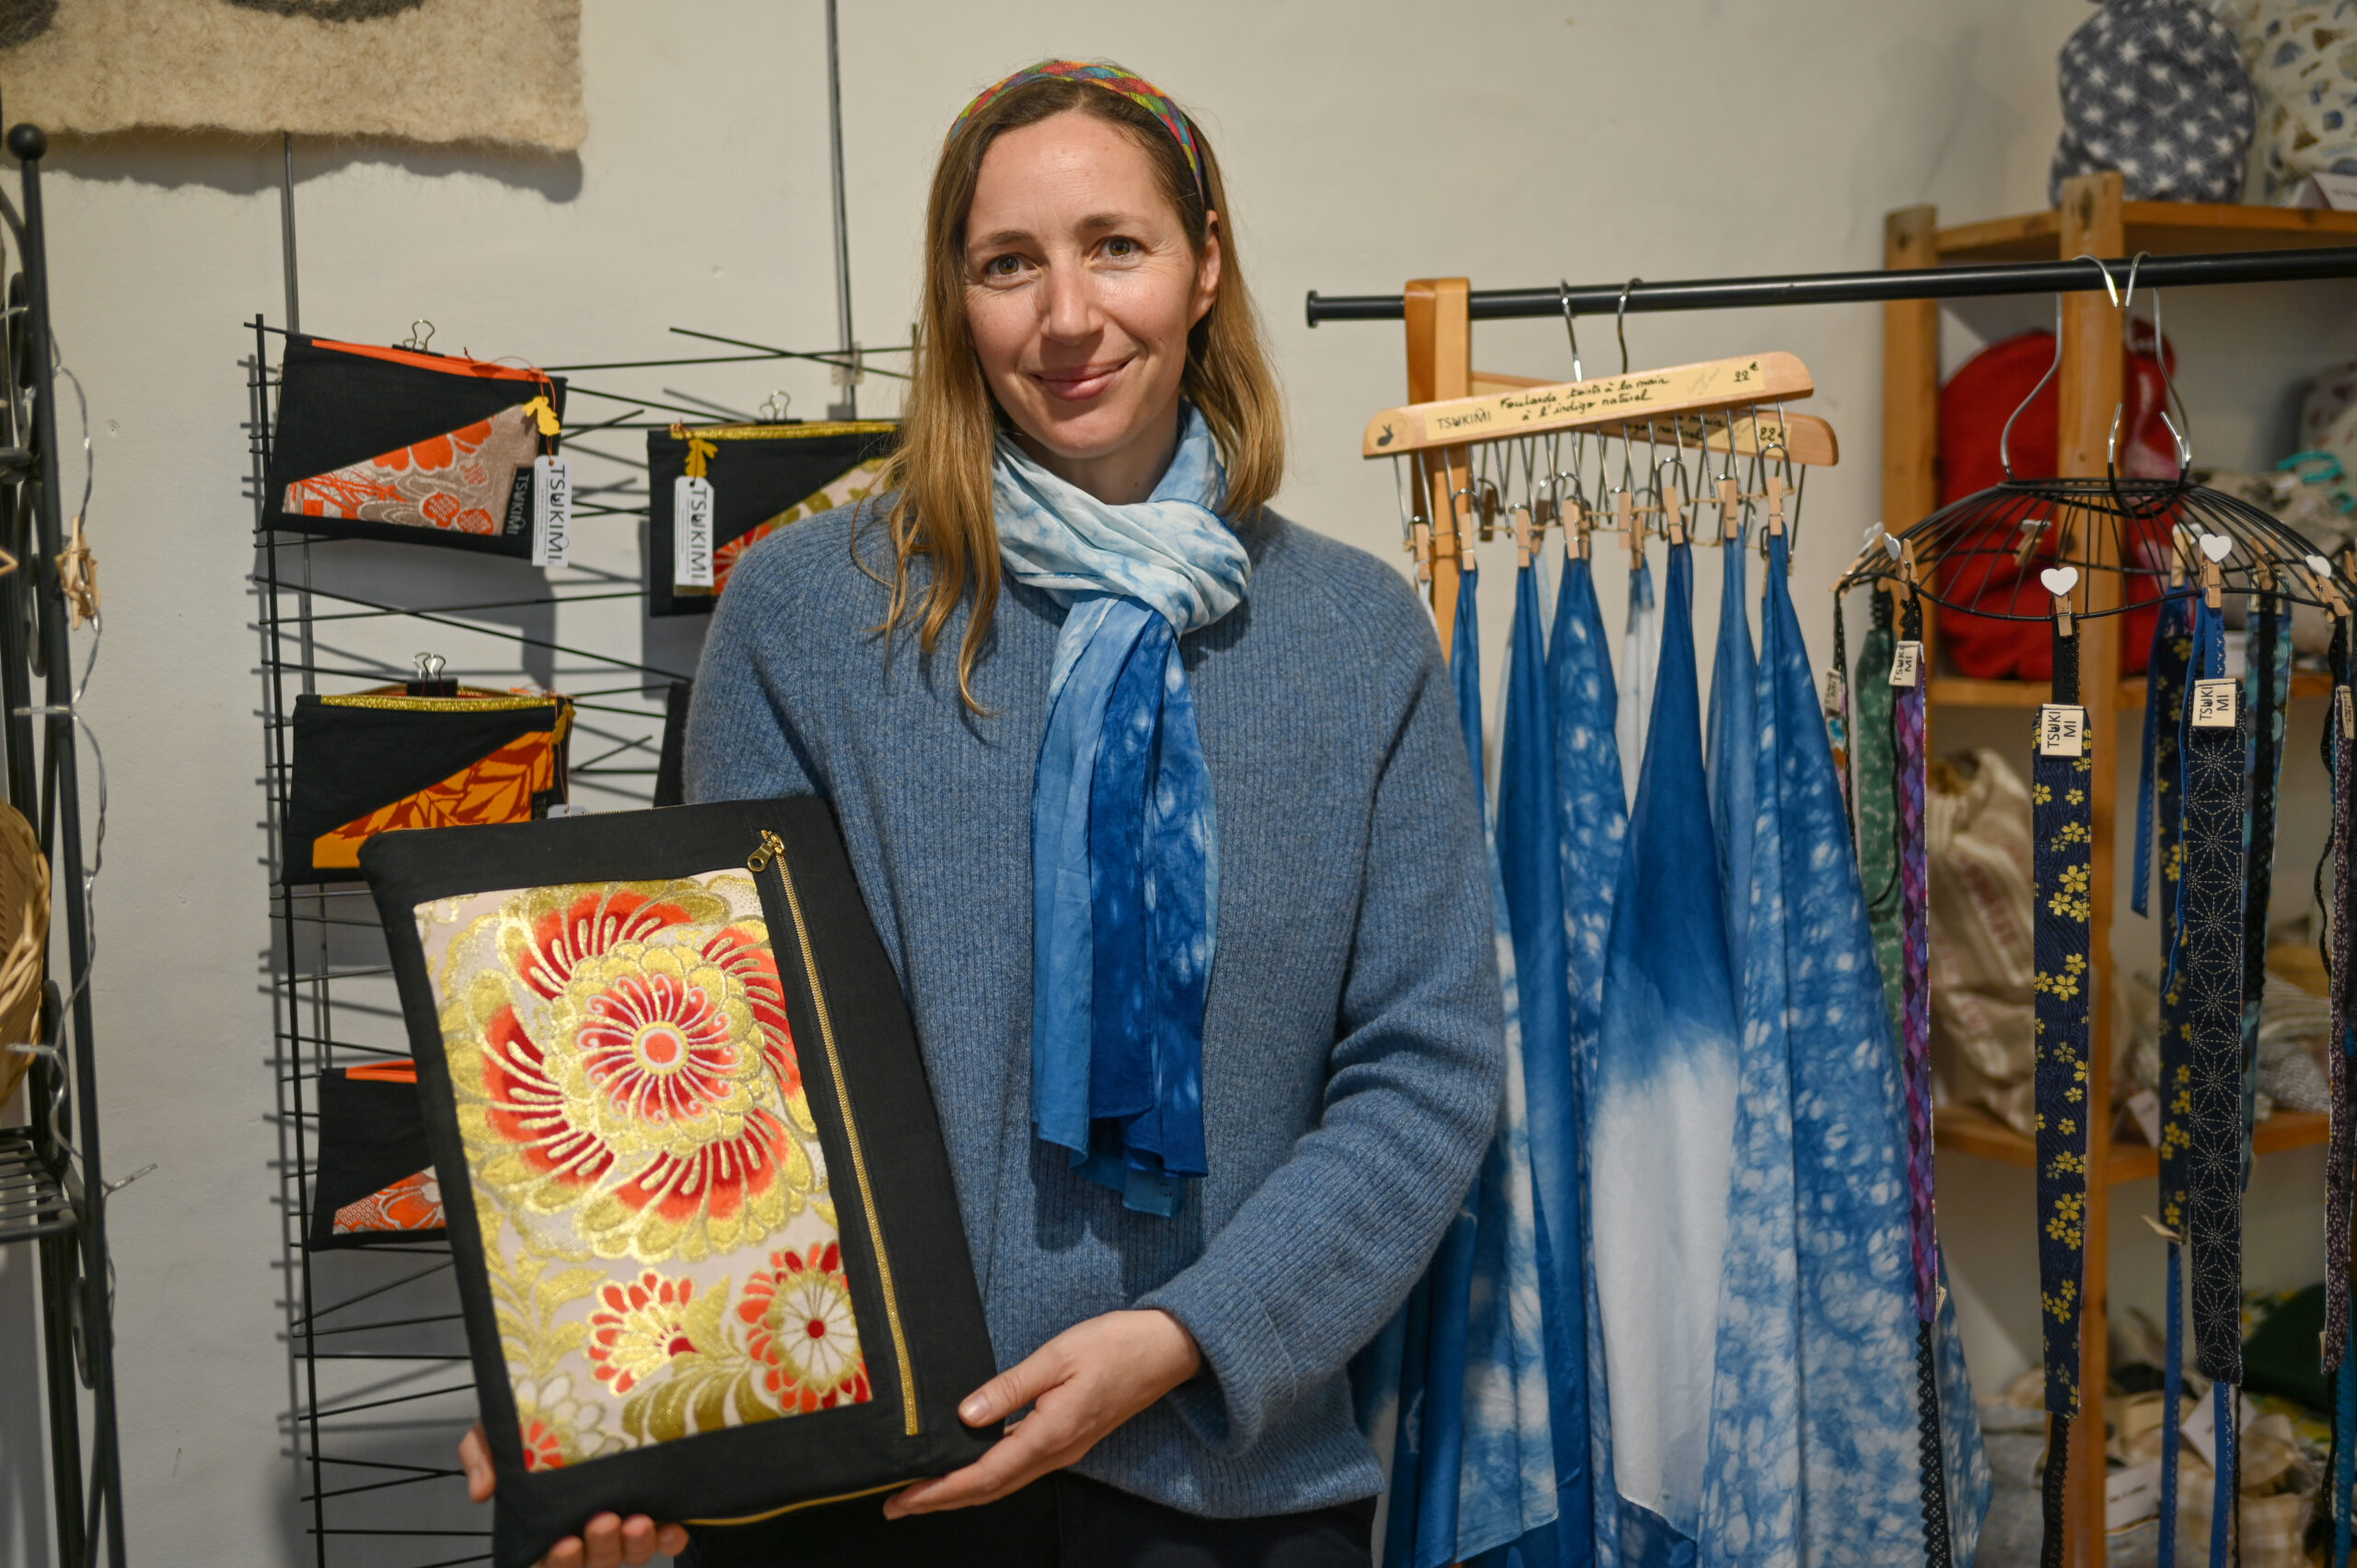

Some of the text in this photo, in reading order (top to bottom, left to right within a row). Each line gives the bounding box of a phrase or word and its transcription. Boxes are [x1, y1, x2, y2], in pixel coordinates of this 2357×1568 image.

[1605, 382, 1614, 393] à
[1618, 379, 1632, 390] la
[1636, 376, 1670, 388] main
[1436, 409, 1492, 431] TSUKIMI
[506, 473, 530, 535] TSUKIMI
[548, 464, 566, 560] TSUKIMI
[691, 486, 707, 579] TSUKIMI
[1892, 646, 1905, 682] TSUKI
[1905, 656, 1913, 672] MI
[2199, 686, 2213, 721] TSUKI
[2216, 694, 2229, 711] MI
[2047, 711, 2061, 749] TSUKI
[2063, 720, 2077, 738] MI
